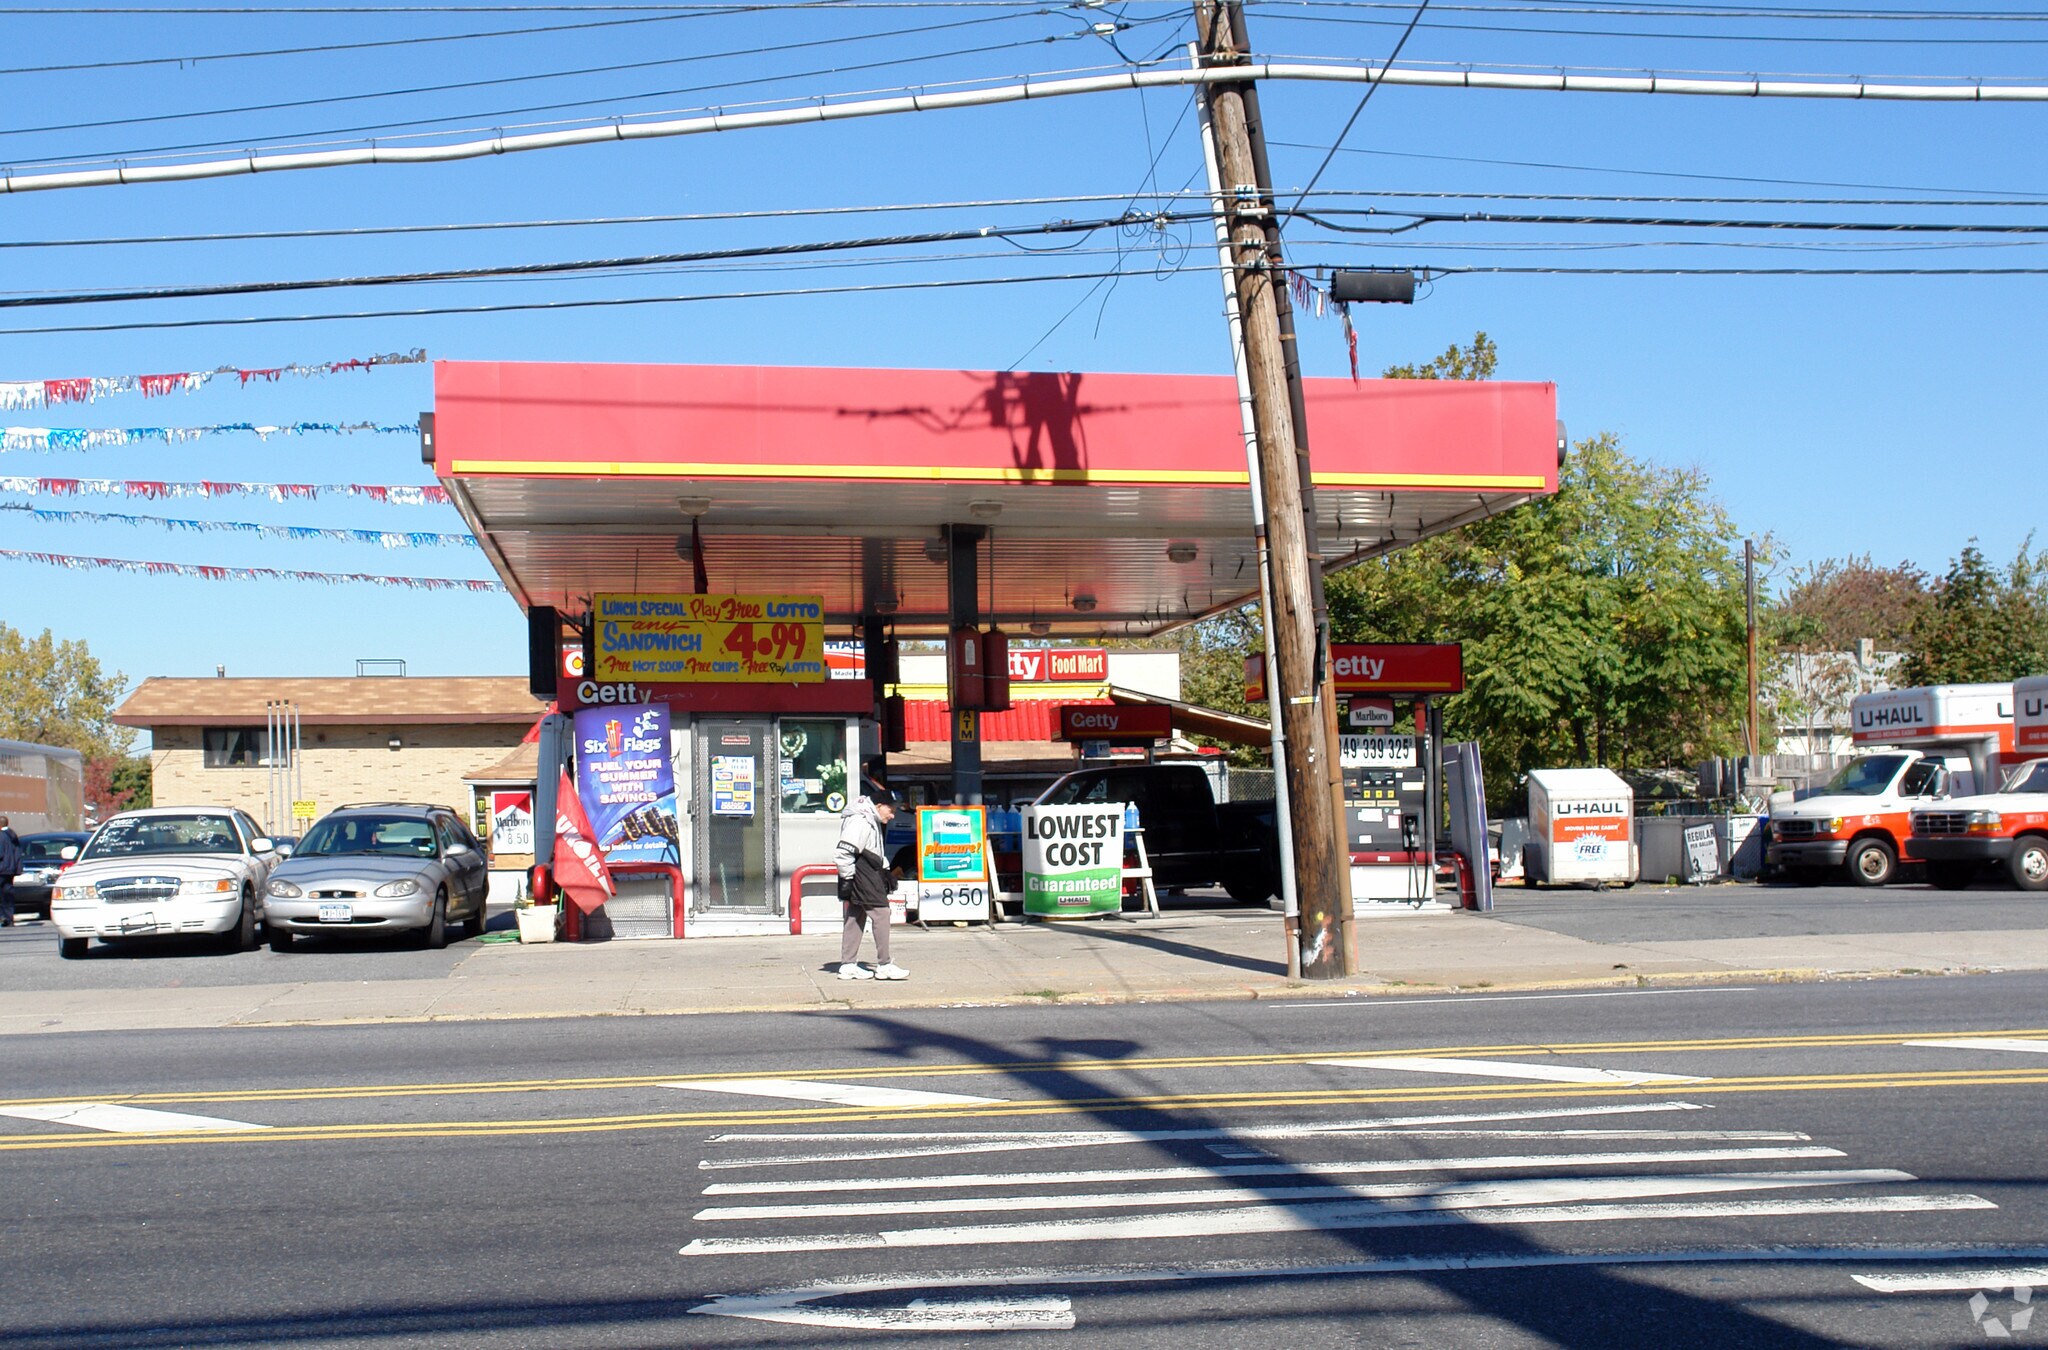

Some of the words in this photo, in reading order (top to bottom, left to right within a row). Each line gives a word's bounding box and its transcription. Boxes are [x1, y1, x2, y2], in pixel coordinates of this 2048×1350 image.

[602, 600, 638, 616] LUNCH
[640, 600, 687, 616] SPECIAL
[689, 598, 720, 622] Play
[721, 598, 763, 620] Free
[766, 602, 820, 618] LOTTO
[632, 621, 690, 635] any
[602, 621, 702, 652] SANDWICH
[723, 623, 806, 660] 4.99
[603, 655, 631, 673] Free
[632, 660, 657, 672] HOT
[657, 660, 684, 673] SOUP
[686, 656, 712, 674] Free
[712, 661, 739, 672] CHIPS
[742, 659, 769, 675] Free
[786, 662, 821, 673] LOTTO
[1051, 655, 1076, 674] Food
[1078, 654, 1103, 673] Mart
[1332, 655, 1385, 680] etty
[577, 681, 652, 705] Getty
[1071, 711, 1119, 730] Getty
[1355, 710, 1388, 721] Marlboro
[1861, 706, 1923, 727] U-HAUL
[961, 710, 973, 739] ATM
[584, 739, 607, 753] Six
[624, 737, 661, 753] Flags
[590, 762, 623, 772] FUEL
[624, 759, 662, 770] YOUR
[600, 770, 658, 783] SUMMER
[611, 782, 644, 792] WITH
[600, 792, 657, 804] SAVINGS
[1557, 803, 1624, 814] U-HAUL
[943, 820, 969, 828] Newport
[1028, 814, 1120, 839] LOWEST
[1687, 828, 1714, 843] REGULAR
[633, 841, 643, 850] for
[644, 840, 667, 849] details
[924, 841, 981, 857] pleasure!
[1579, 844, 1602, 854] FREE
[1046, 842, 1103, 866] COST
[1029, 875, 1118, 893] Guaranteed
